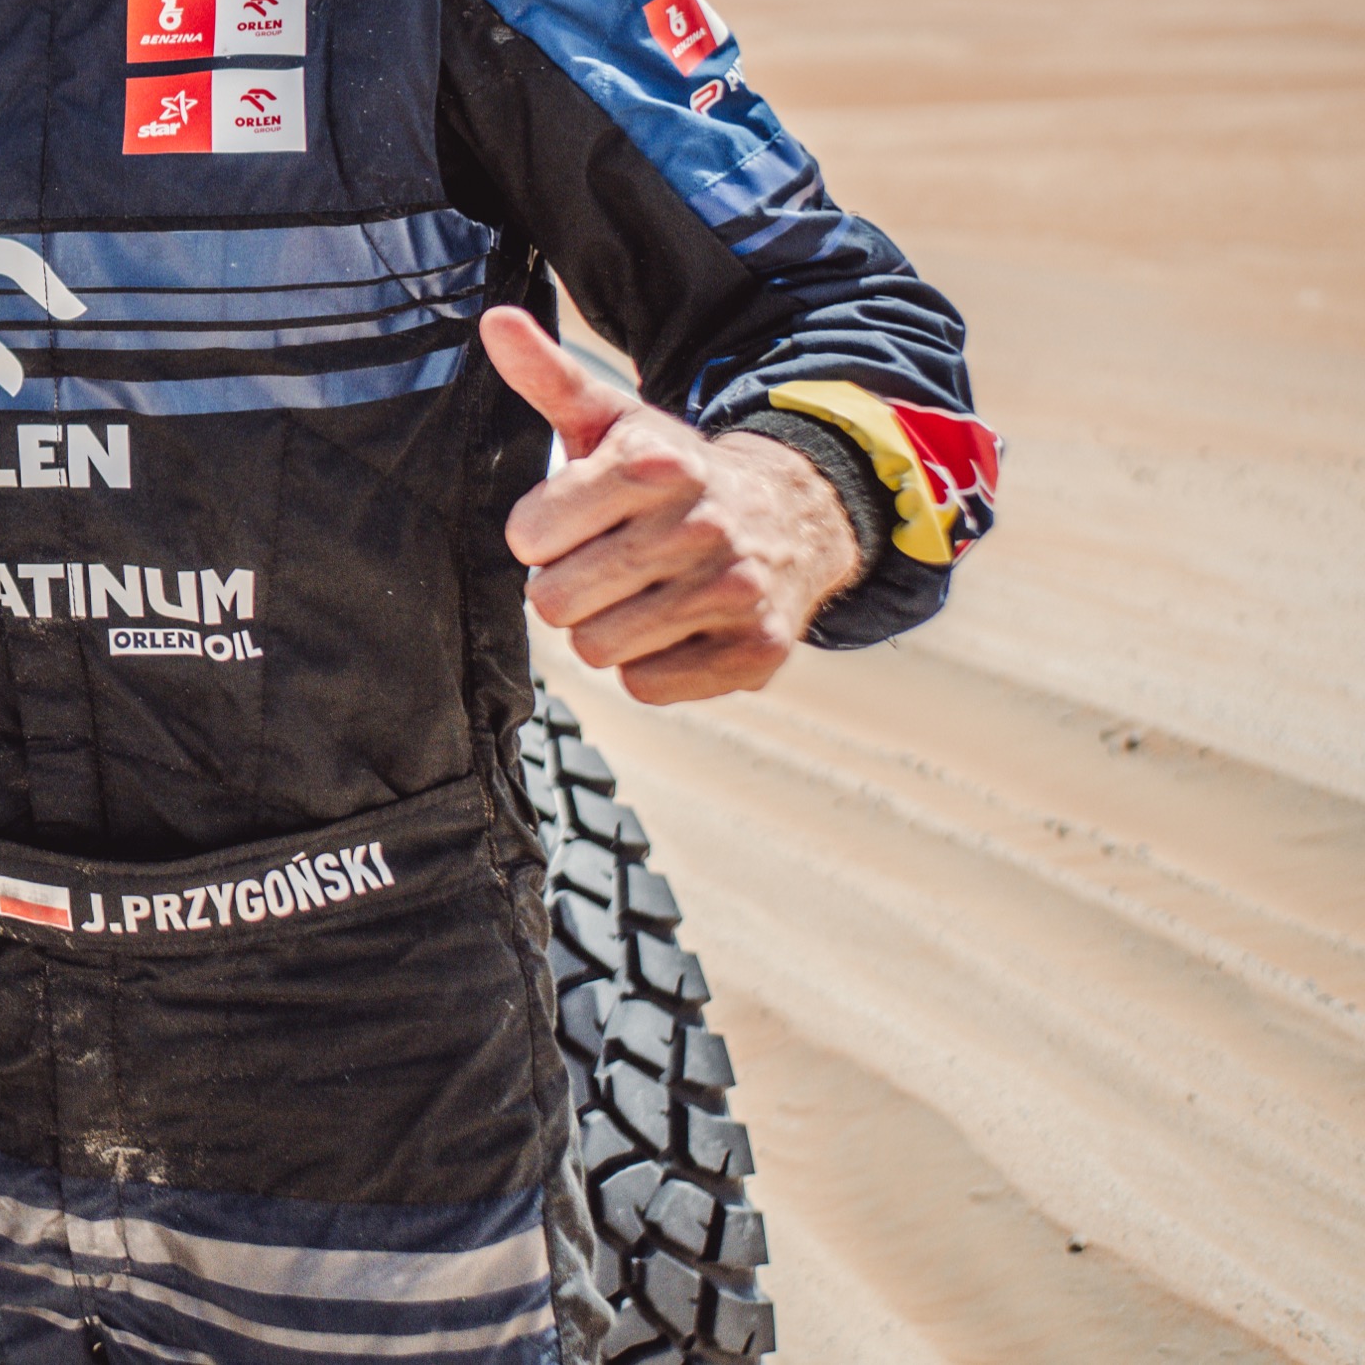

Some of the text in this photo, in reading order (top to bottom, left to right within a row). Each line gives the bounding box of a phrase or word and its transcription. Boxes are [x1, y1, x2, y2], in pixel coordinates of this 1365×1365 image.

[237, 19, 282, 32] ORLEN
[140, 32, 203, 46] BENZINA
[138, 120, 181, 138] star
[234, 115, 281, 128] ORLEN
[114, 629, 263, 661] ORLEN OIL
[81, 841, 395, 933] J.PRZYGOŃSKI
